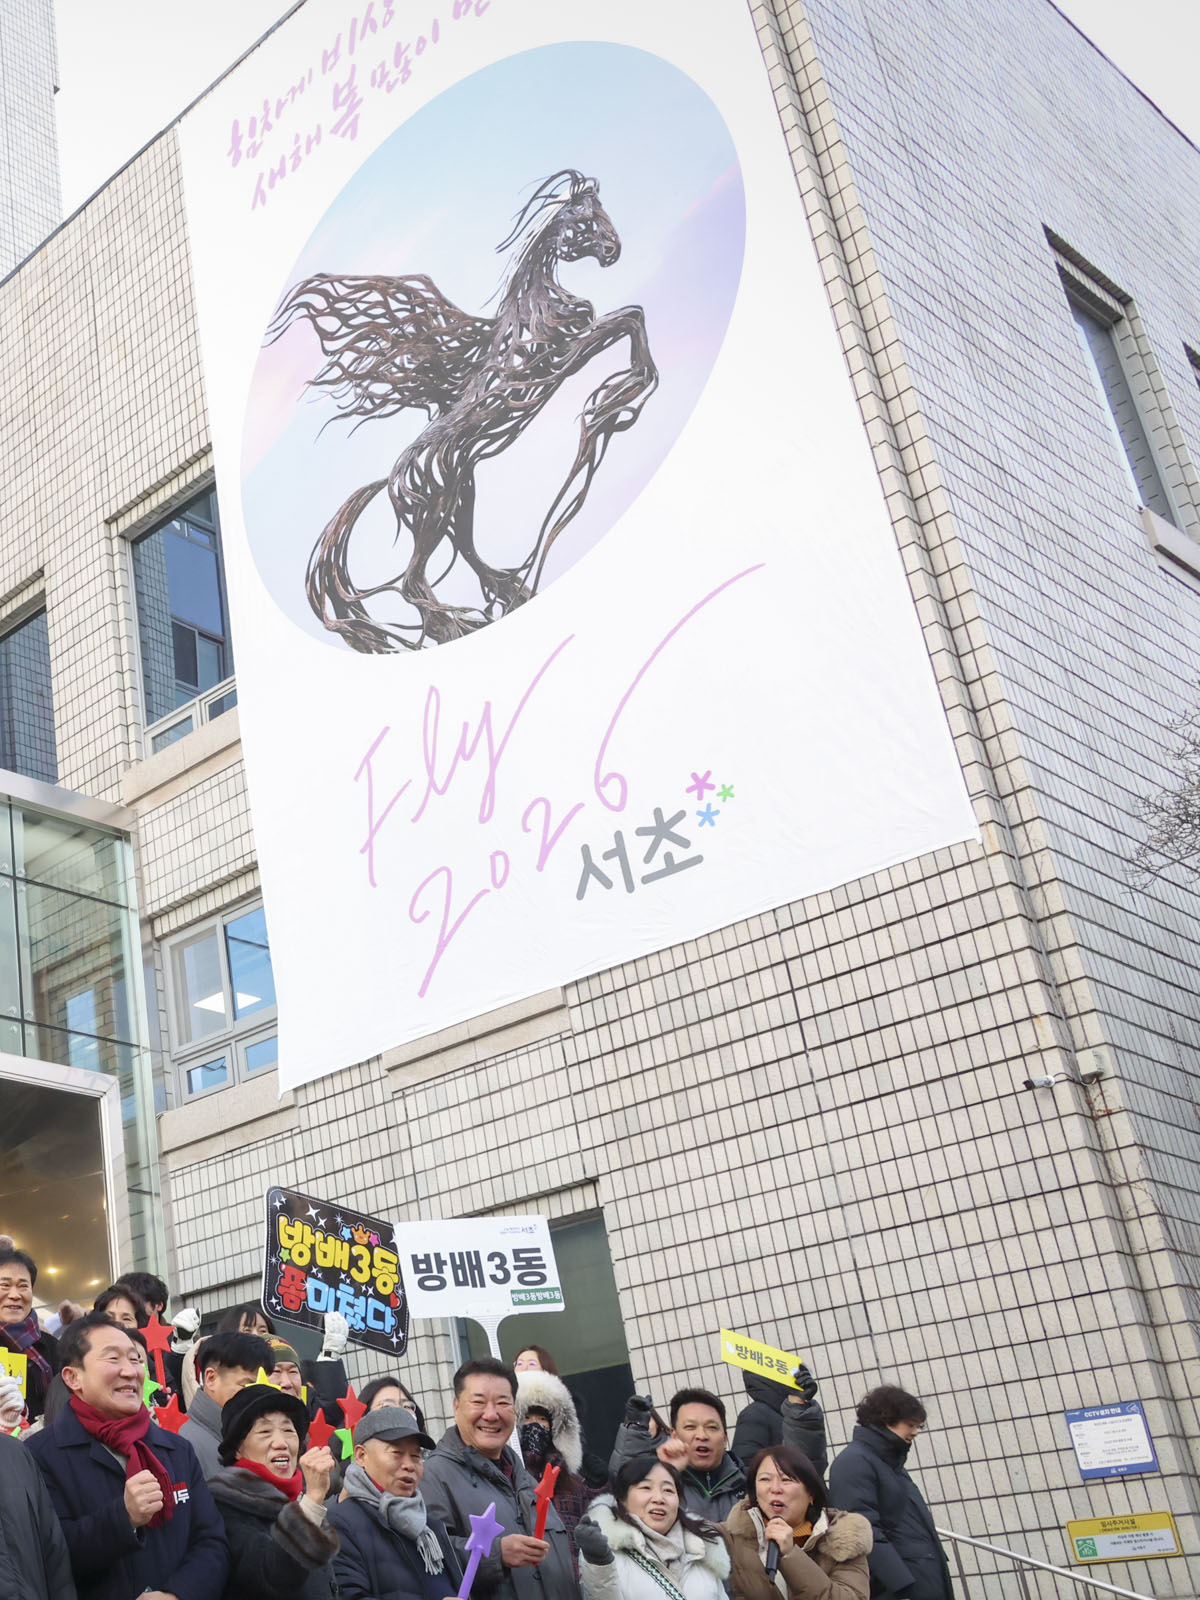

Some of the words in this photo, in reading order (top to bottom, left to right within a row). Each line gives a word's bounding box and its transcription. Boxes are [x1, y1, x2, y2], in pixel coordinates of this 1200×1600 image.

[251, 123, 322, 210] 새해
[329, 63, 363, 141] 복
[353, 633, 576, 887] Fly
[408, 563, 767, 997] 2026
[574, 806, 704, 901] 서초
[278, 1215, 400, 1296] 방배3동
[411, 1247, 548, 1292] 방배3동
[735, 1344, 789, 1375] 방배3동
